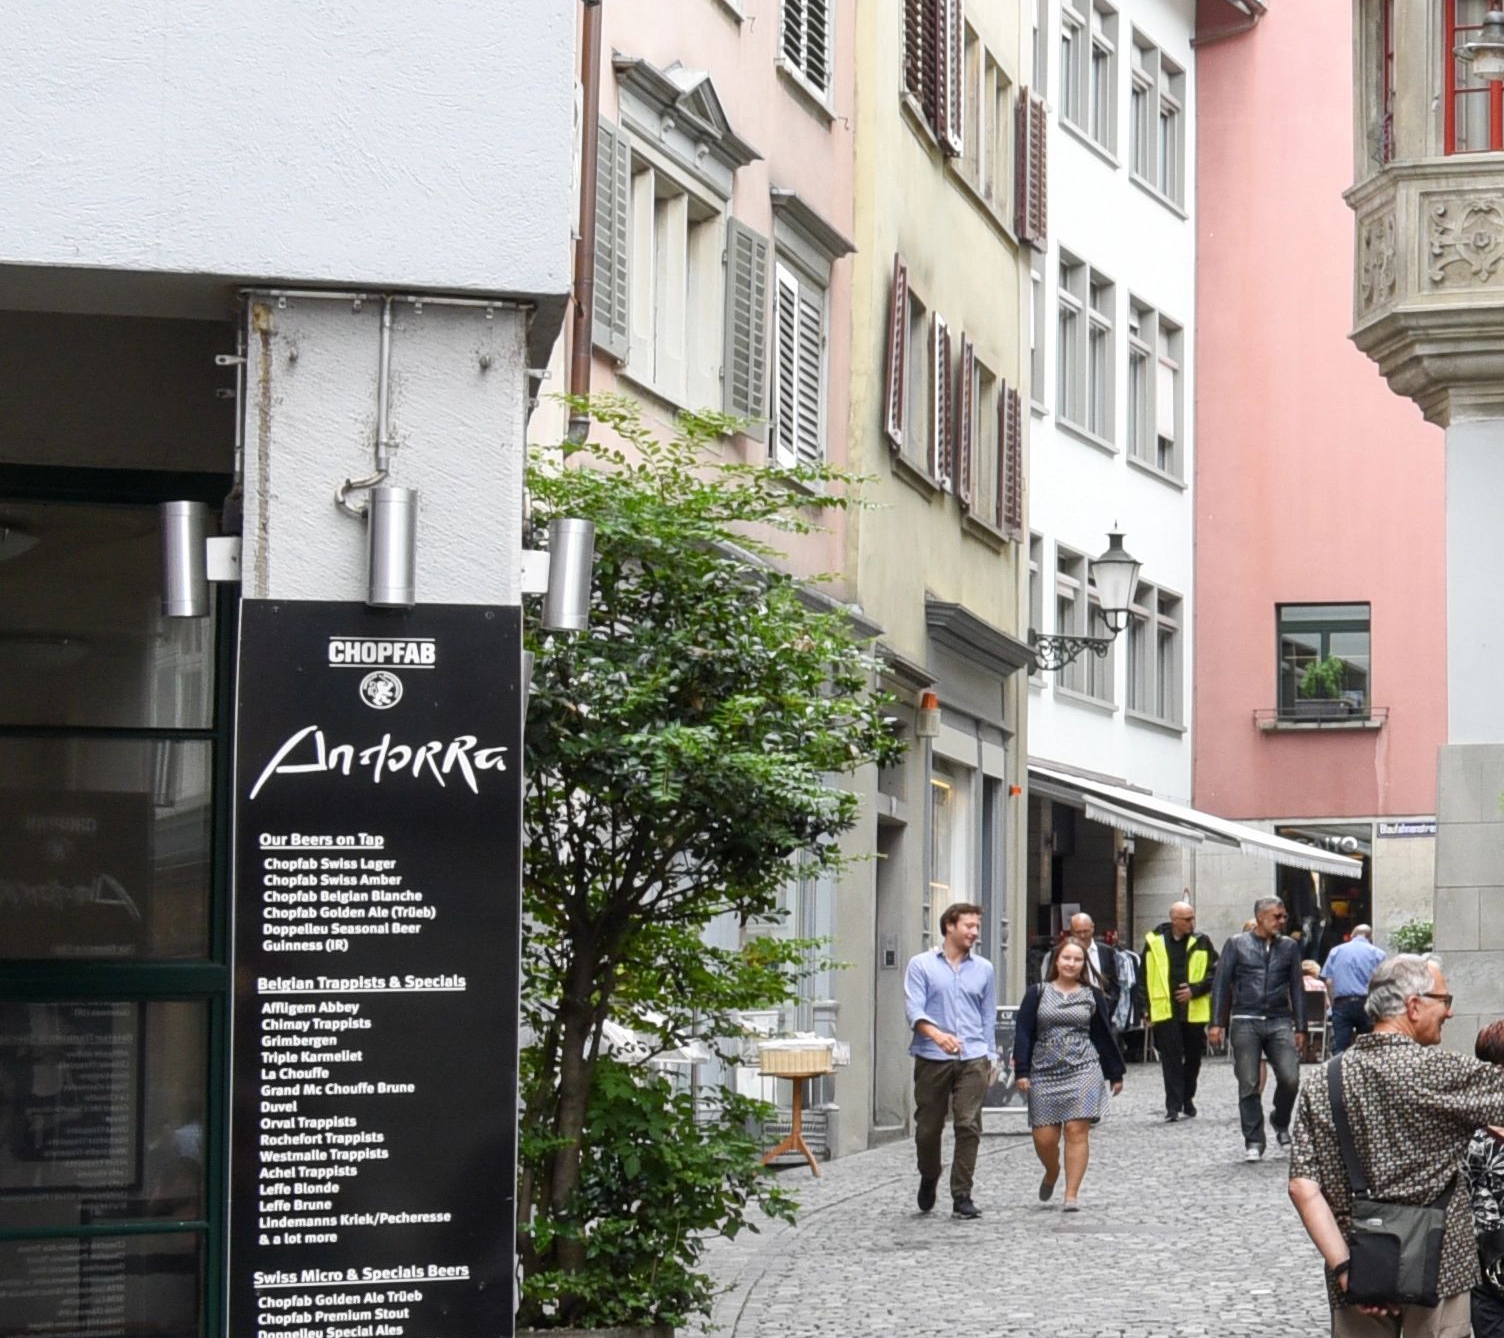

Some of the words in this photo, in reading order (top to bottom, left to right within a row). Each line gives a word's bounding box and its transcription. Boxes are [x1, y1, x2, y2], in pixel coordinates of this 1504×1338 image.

[328, 641, 436, 664] CHOPFAB
[259, 834, 286, 847] Our
[291, 834, 332, 847] Beers
[336, 836, 355, 847] on
[359, 833, 385, 849] Tap
[263, 857, 318, 872] Chopfab
[320, 857, 358, 870] Swiss
[360, 857, 397, 872] Lager
[263, 873, 318, 889] Chopfab
[320, 873, 358, 886] Swiss
[359, 873, 402, 886] Amber
[263, 890, 318, 905] Chopfab
[320, 889, 369, 905] Belgian
[371, 889, 423, 902] Blanche
[263, 904, 318, 921] Chopfab
[319, 906, 366, 918] Golden
[367, 906, 389, 918] Ale
[390, 905, 437, 920] (Trüeb)
[263, 920, 329, 938] Doppelleu
[330, 922, 390, 935] Seasonal
[391, 922, 422, 934] Beer
[262, 937, 324, 952] Guinness
[325, 938, 349, 953] (IR)
[257, 977, 314, 991] Belgian
[317, 975, 386, 991] Trappists
[389, 976, 401, 988] &
[405, 974, 466, 989] Specials
[261, 1001, 316, 1016] Affligem
[318, 1001, 360, 1015] Abbey
[261, 1015, 311, 1033] Chimay
[311, 1017, 372, 1032] Trappists
[261, 1032, 338, 1049] Grimbergen
[261, 1068, 277, 1080] La
[278, 1066, 330, 1080] Chouffe
[260, 1100, 298, 1113] Duvel
[260, 1116, 296, 1130] Orval
[297, 1115, 357, 1131] Trappists
[259, 1182, 292, 1196] Leffe
[293, 1181, 340, 1195] Blonde
[259, 1199, 291, 1212] Leffe
[293, 1199, 333, 1211] Brune
[254, 1271, 298, 1285] Swiss
[301, 1268, 343, 1283] Micro
[346, 1268, 359, 1281] &
[362, 1265, 425, 1282] Specials
[427, 1263, 470, 1278] Beers
